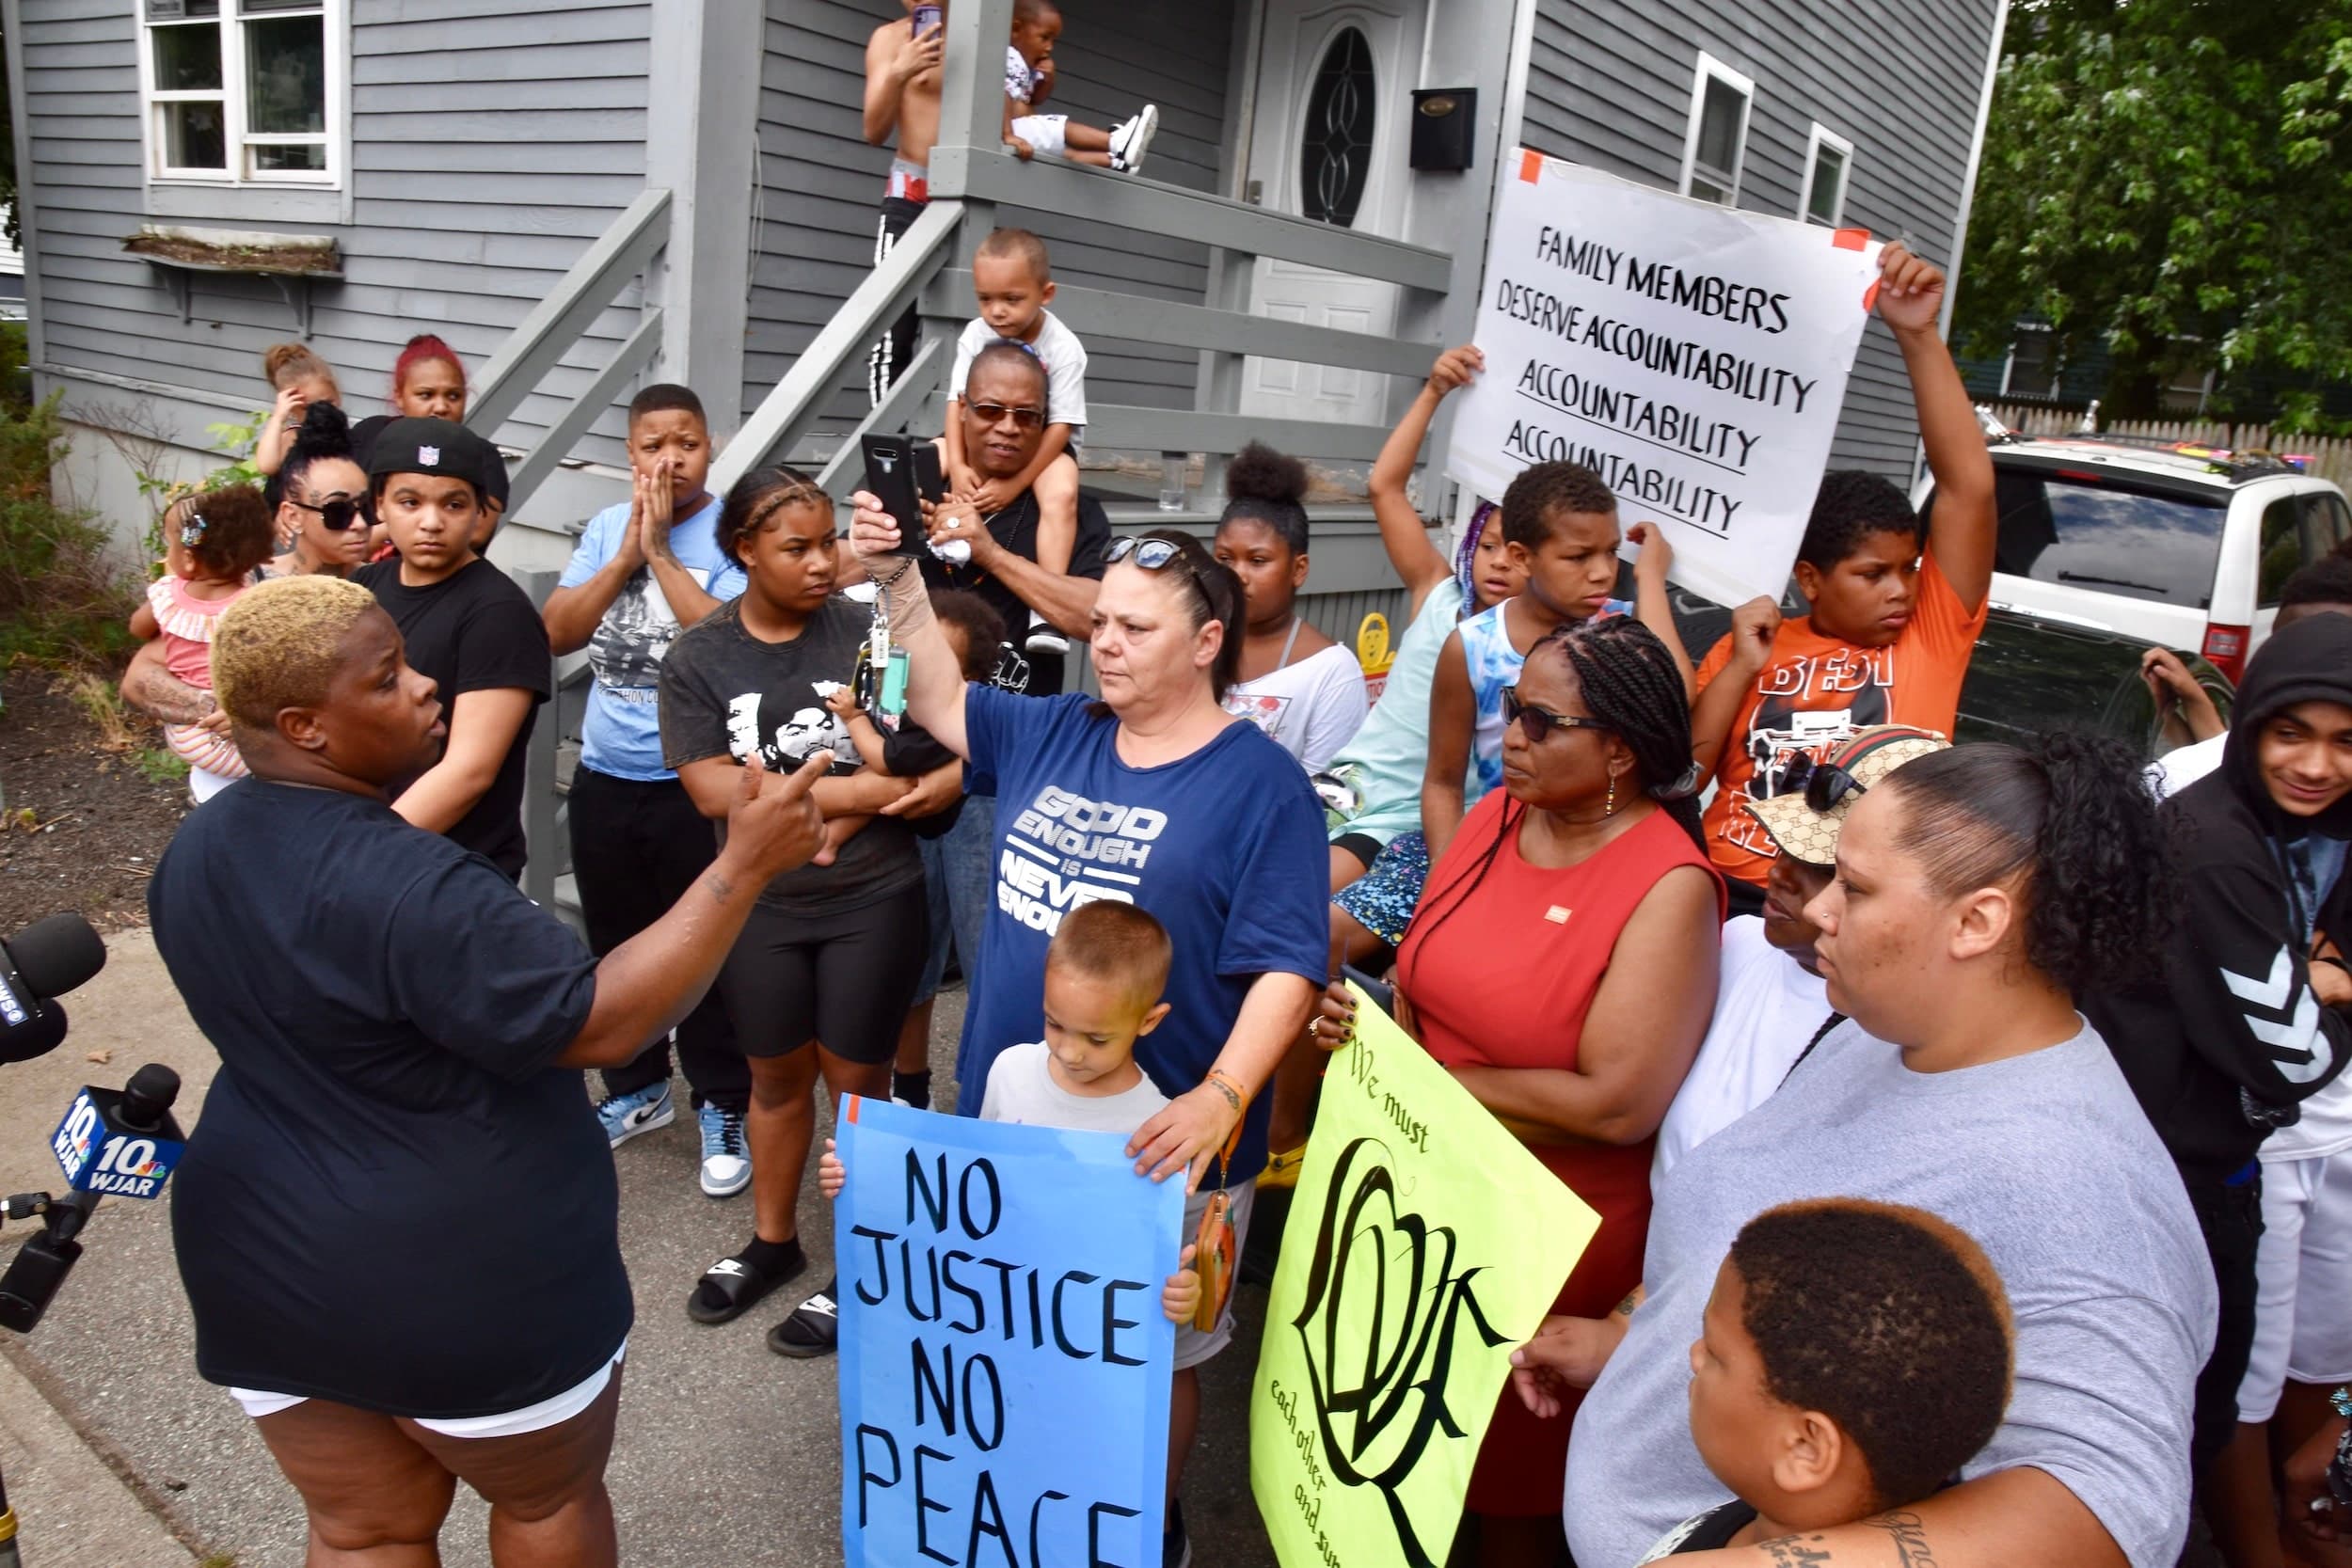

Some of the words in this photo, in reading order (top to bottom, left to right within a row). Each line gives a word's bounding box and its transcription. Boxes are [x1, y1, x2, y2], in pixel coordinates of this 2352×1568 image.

[1536, 225, 1624, 284] FAMILY
[1626, 257, 1791, 334] MEMBERS
[1497, 278, 1581, 342] DESERVE
[1582, 315, 1819, 414] ACCOUNTABILITY
[1518, 358, 1761, 467] ACCOUNTABILITY
[1012, 809, 1152, 869] ENOUGH
[1033, 785, 1168, 841] GOOD
[1059, 858, 1082, 877] IS
[64, 1094, 97, 1147] 10
[1348, 1034, 1379, 1099] We
[1382, 1092, 1430, 1153] must
[54, 1130, 82, 1180] WJAR
[88, 1172, 155, 1196] WJAR
[96, 1135, 157, 1176] 10
[905, 1147, 1002, 1241] NO
[850, 1224, 1151, 1367] JUSTICE
[911, 1337, 1005, 1451] NO
[1271, 1380, 1296, 1434] each
[1296, 1430, 1327, 1491] other
[1295, 1484, 1321, 1533] and
